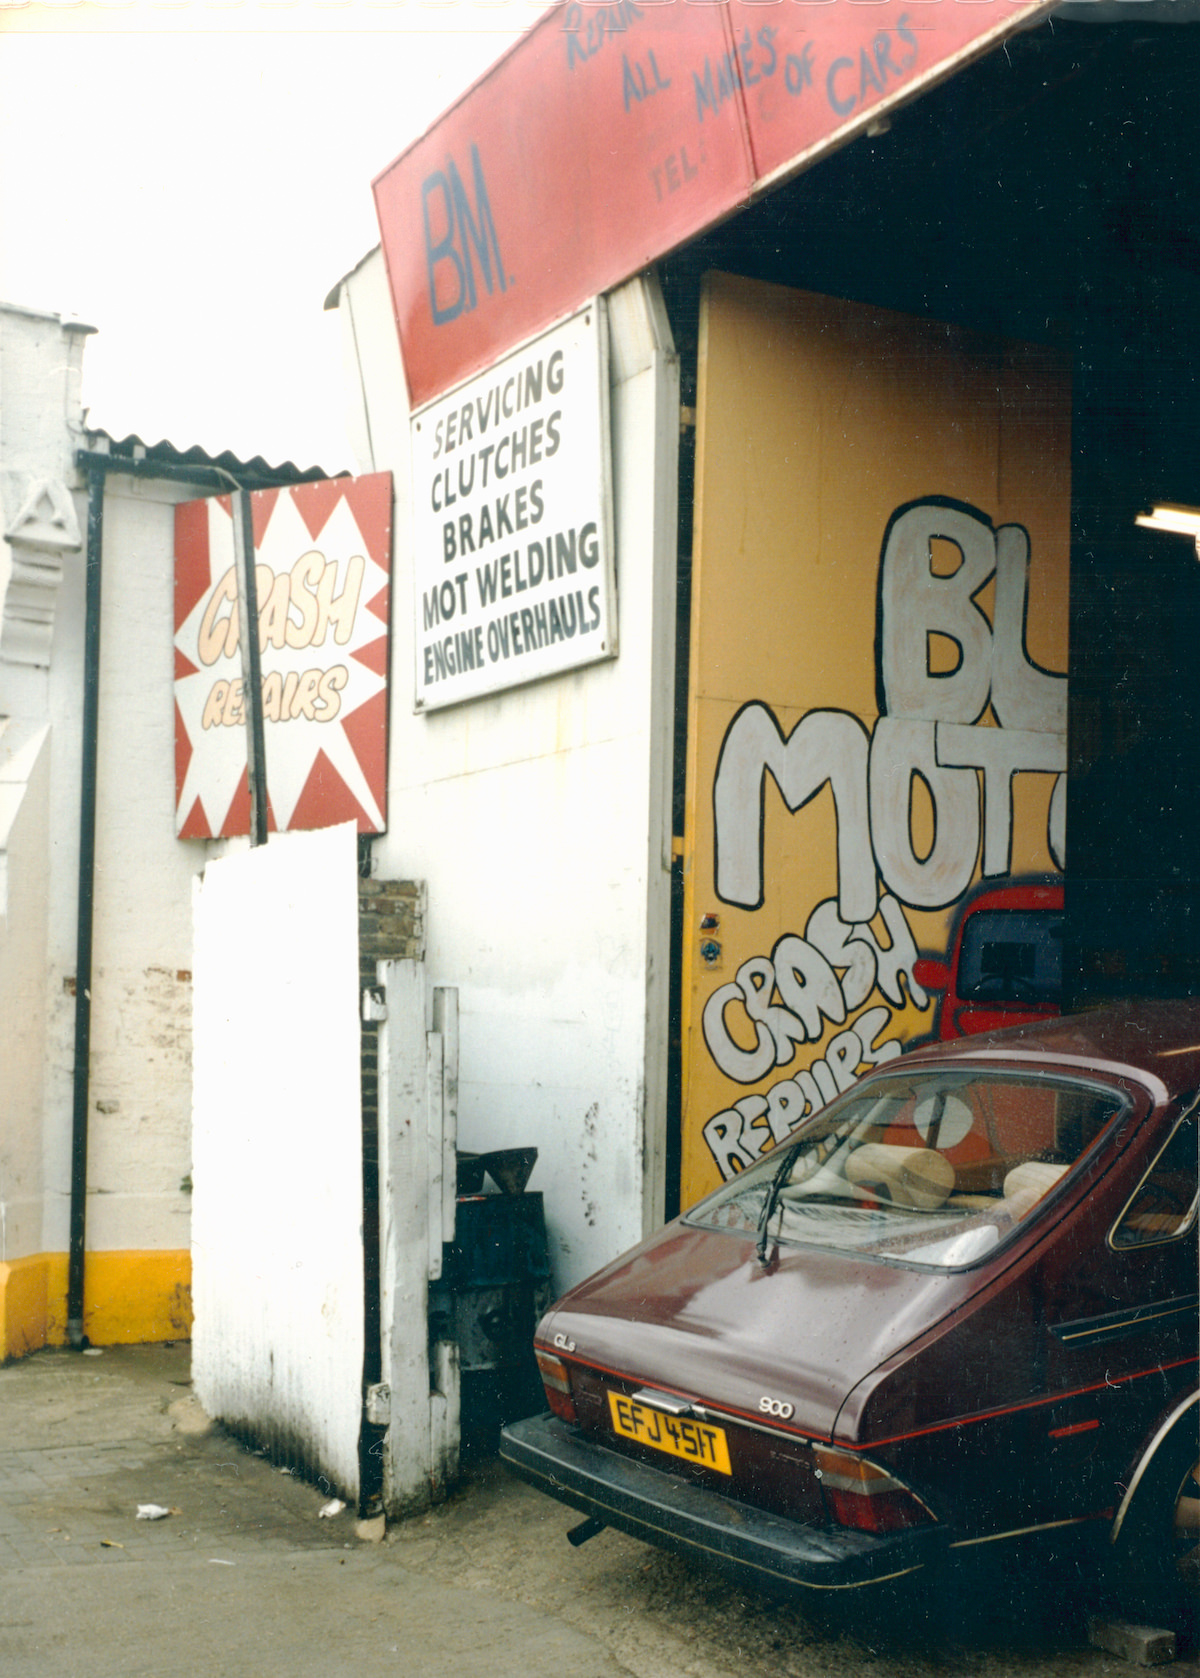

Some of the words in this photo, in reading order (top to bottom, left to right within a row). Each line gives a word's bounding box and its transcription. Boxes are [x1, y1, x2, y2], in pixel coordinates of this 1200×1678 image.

[622, 48, 672, 113] ALL
[692, 25, 779, 123] MAKES
[784, 40, 814, 96] OF
[826, 13, 918, 117] CARS
[432, 350, 564, 460] SERVICING
[431, 410, 562, 513] CLUTCHES
[443, 479, 544, 564] BRAKES
[198, 550, 365, 667] CRASH
[422, 573, 469, 632] MOT
[476, 522, 600, 608] WELDING
[423, 625, 485, 685] ENGINE
[487, 585, 600, 663] OVERHAULS
[702, 893, 931, 1085] CRASH
[616, 1399, 662, 1443] EFJ
[759, 1396, 794, 1419] 900
